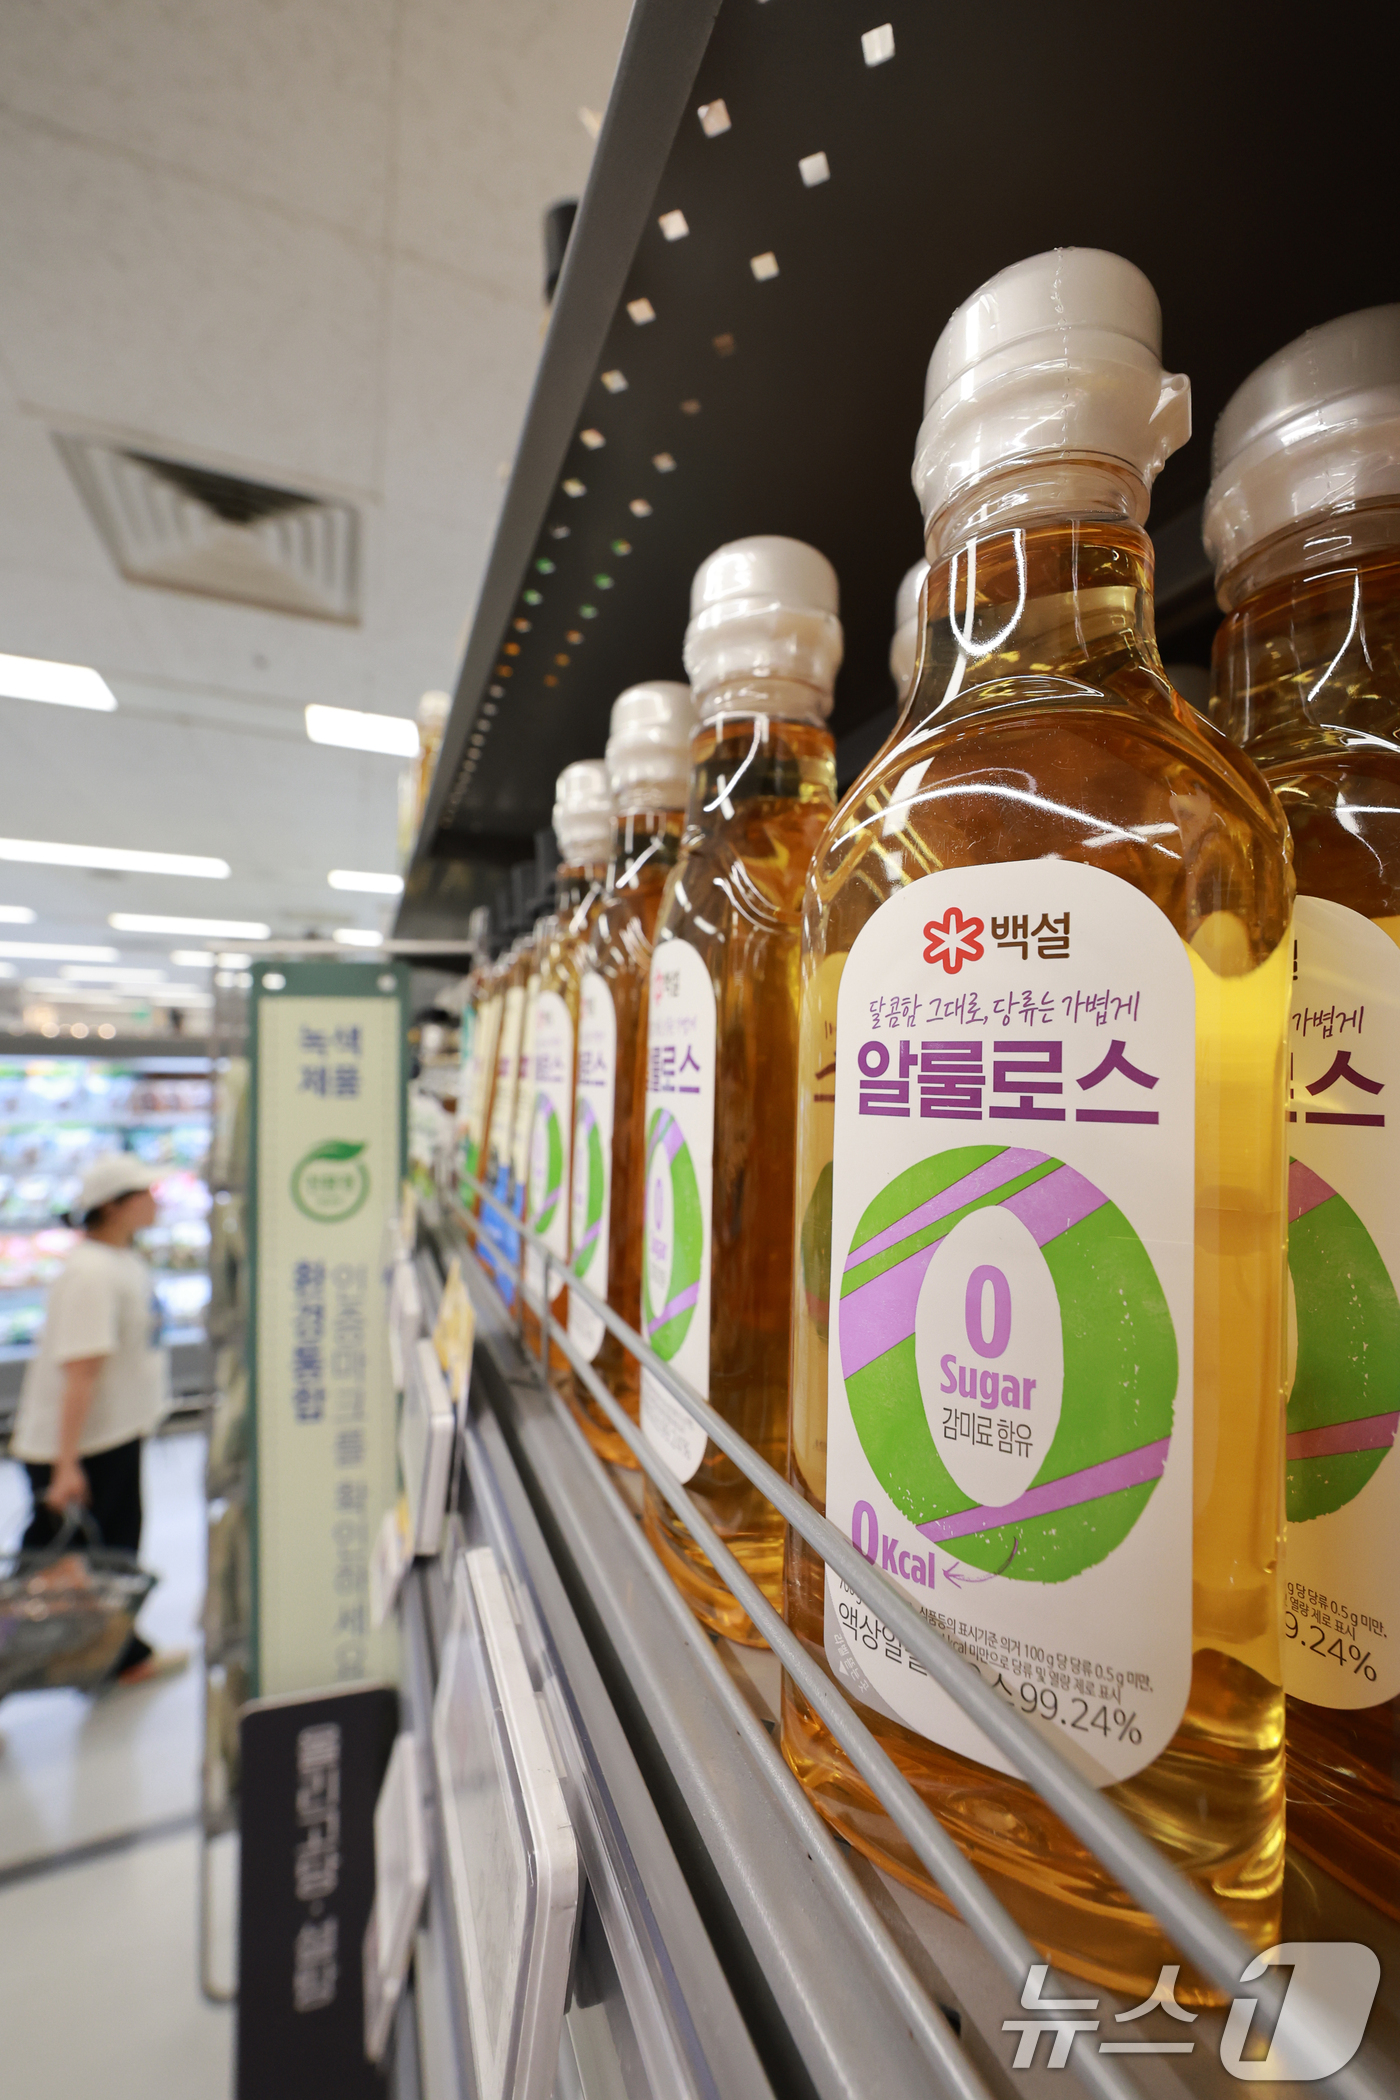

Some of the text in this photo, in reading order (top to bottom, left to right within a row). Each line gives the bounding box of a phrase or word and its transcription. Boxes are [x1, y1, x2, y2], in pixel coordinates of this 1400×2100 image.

[990, 911, 1071, 961] 백설
[869, 988, 1141, 1030] 달콤함 그대로, 당류는 가볍게
[1292, 1005, 1365, 1039] 가볍게
[856, 1038, 1161, 1125] 알룰로스
[965, 1264, 1012, 1359] 0
[940, 1353, 1037, 1411] Sugar
[942, 1407, 1034, 1459] 감미료 함유
[958, 1621, 999, 1650] 표시기준
[1000, 1636, 1021, 1657] 의거
[1311, 1608, 1332, 1629] 제로
[1334, 1619, 1356, 1642] 표시
[969, 1643, 1010, 1671] 미만으로
[1098, 1683, 1122, 1707] 표시
